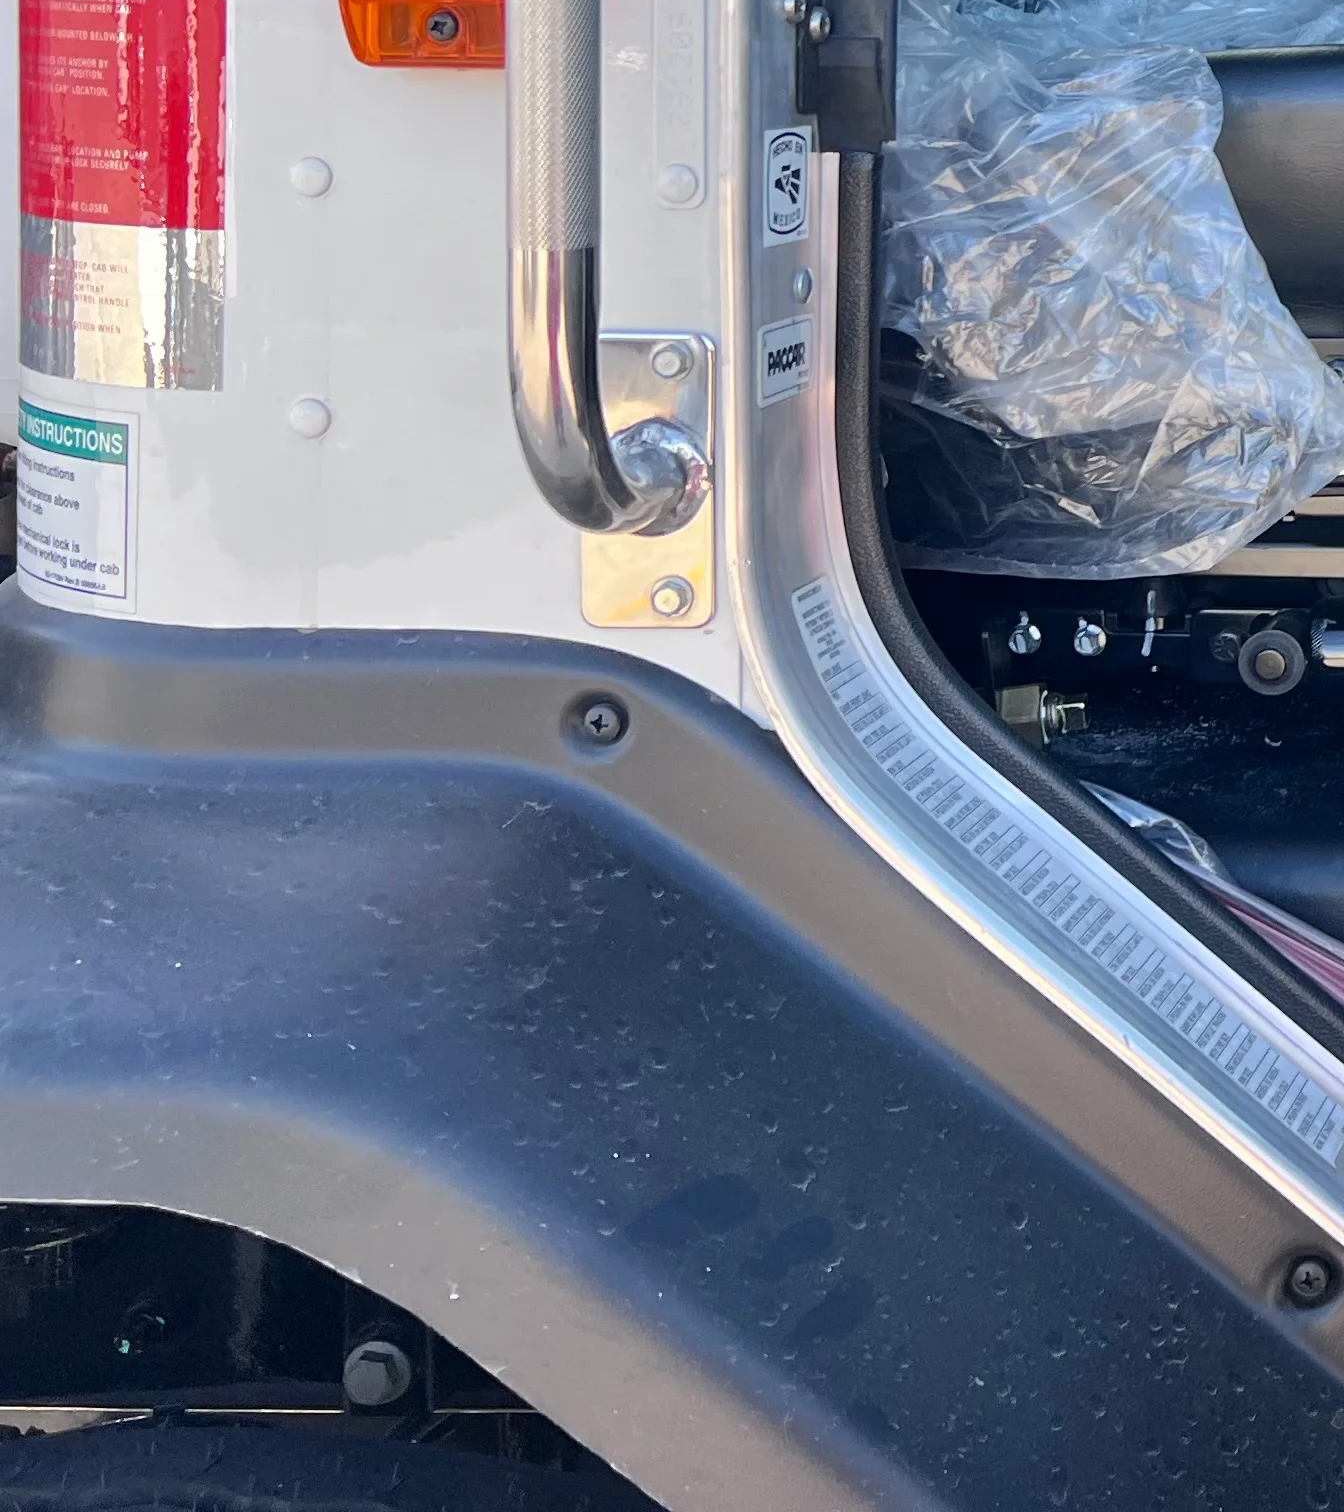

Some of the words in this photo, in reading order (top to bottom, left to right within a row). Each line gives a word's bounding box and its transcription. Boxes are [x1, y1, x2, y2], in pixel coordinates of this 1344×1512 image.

[767, 341, 806, 377] PACCAR
[26, 414, 124, 455] INSTRUCTIONS
[54, 494, 80, 511] above
[52, 535, 70, 551] lock
[72, 539, 81, 554] is
[39, 548, 68, 569] working
[70, 557, 97, 571] under
[100, 562, 120, 576] cab
